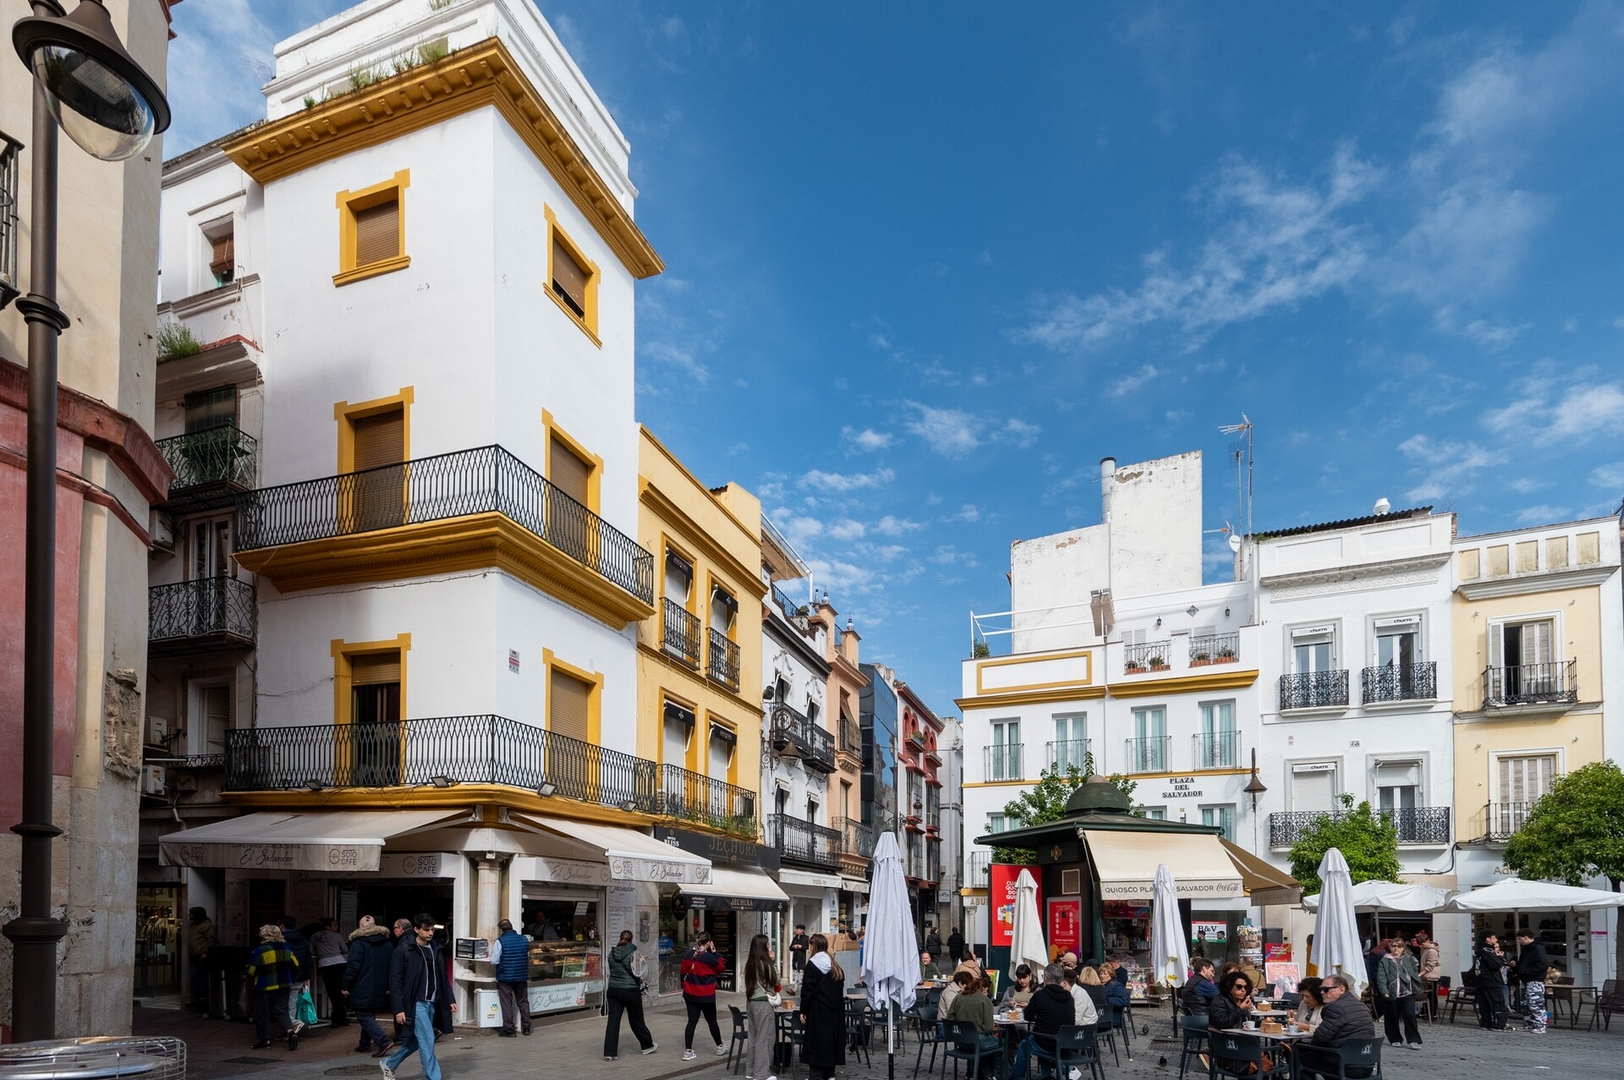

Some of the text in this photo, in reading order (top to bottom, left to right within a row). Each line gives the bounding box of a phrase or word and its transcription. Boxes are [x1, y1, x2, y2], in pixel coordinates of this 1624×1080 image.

[341, 849, 358, 859] SOTO
[708, 837, 757, 856] JECHURA
[240, 849, 294, 866] El Salvador
[417, 855, 437, 866] SOTO
[417, 866, 437, 874] CAFE
[550, 865, 593, 881] El Salvador
[650, 864, 683, 879] El Salvador
[532, 992, 573, 1010] El Salvador
